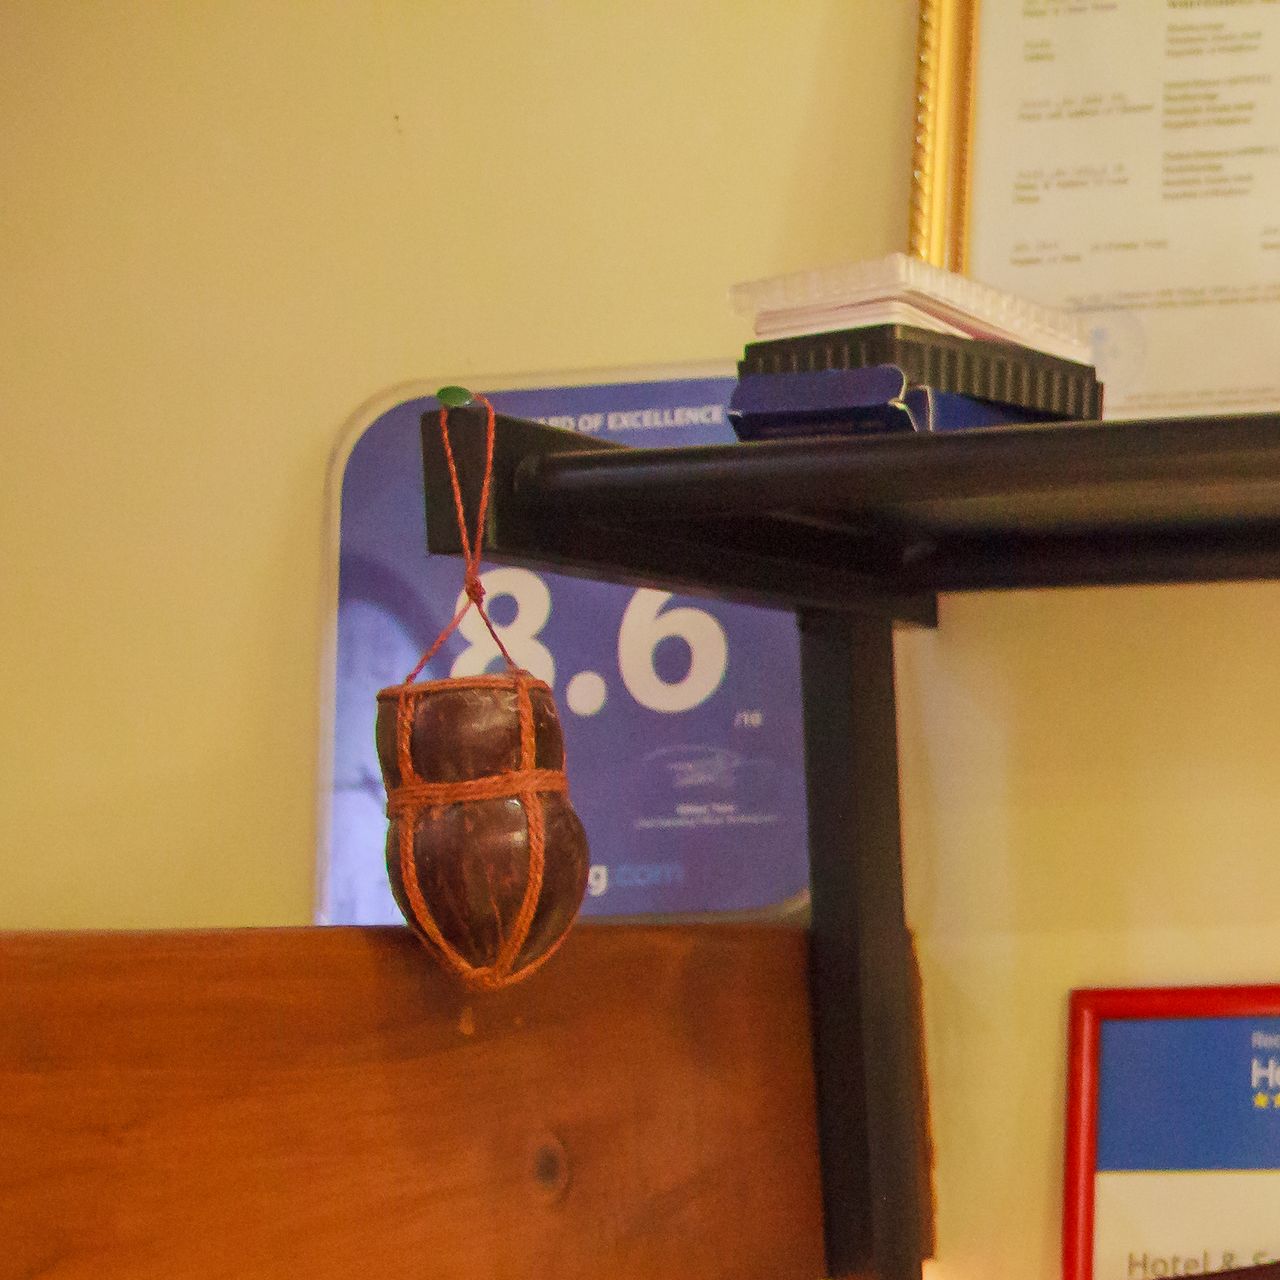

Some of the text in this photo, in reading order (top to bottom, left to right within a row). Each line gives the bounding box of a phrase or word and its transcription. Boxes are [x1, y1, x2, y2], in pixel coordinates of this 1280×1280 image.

[606, 404, 722, 431] EXCELLENCE
[450, 566, 729, 717] 8.6
[1127, 1250, 1209, 1278] Hotel
